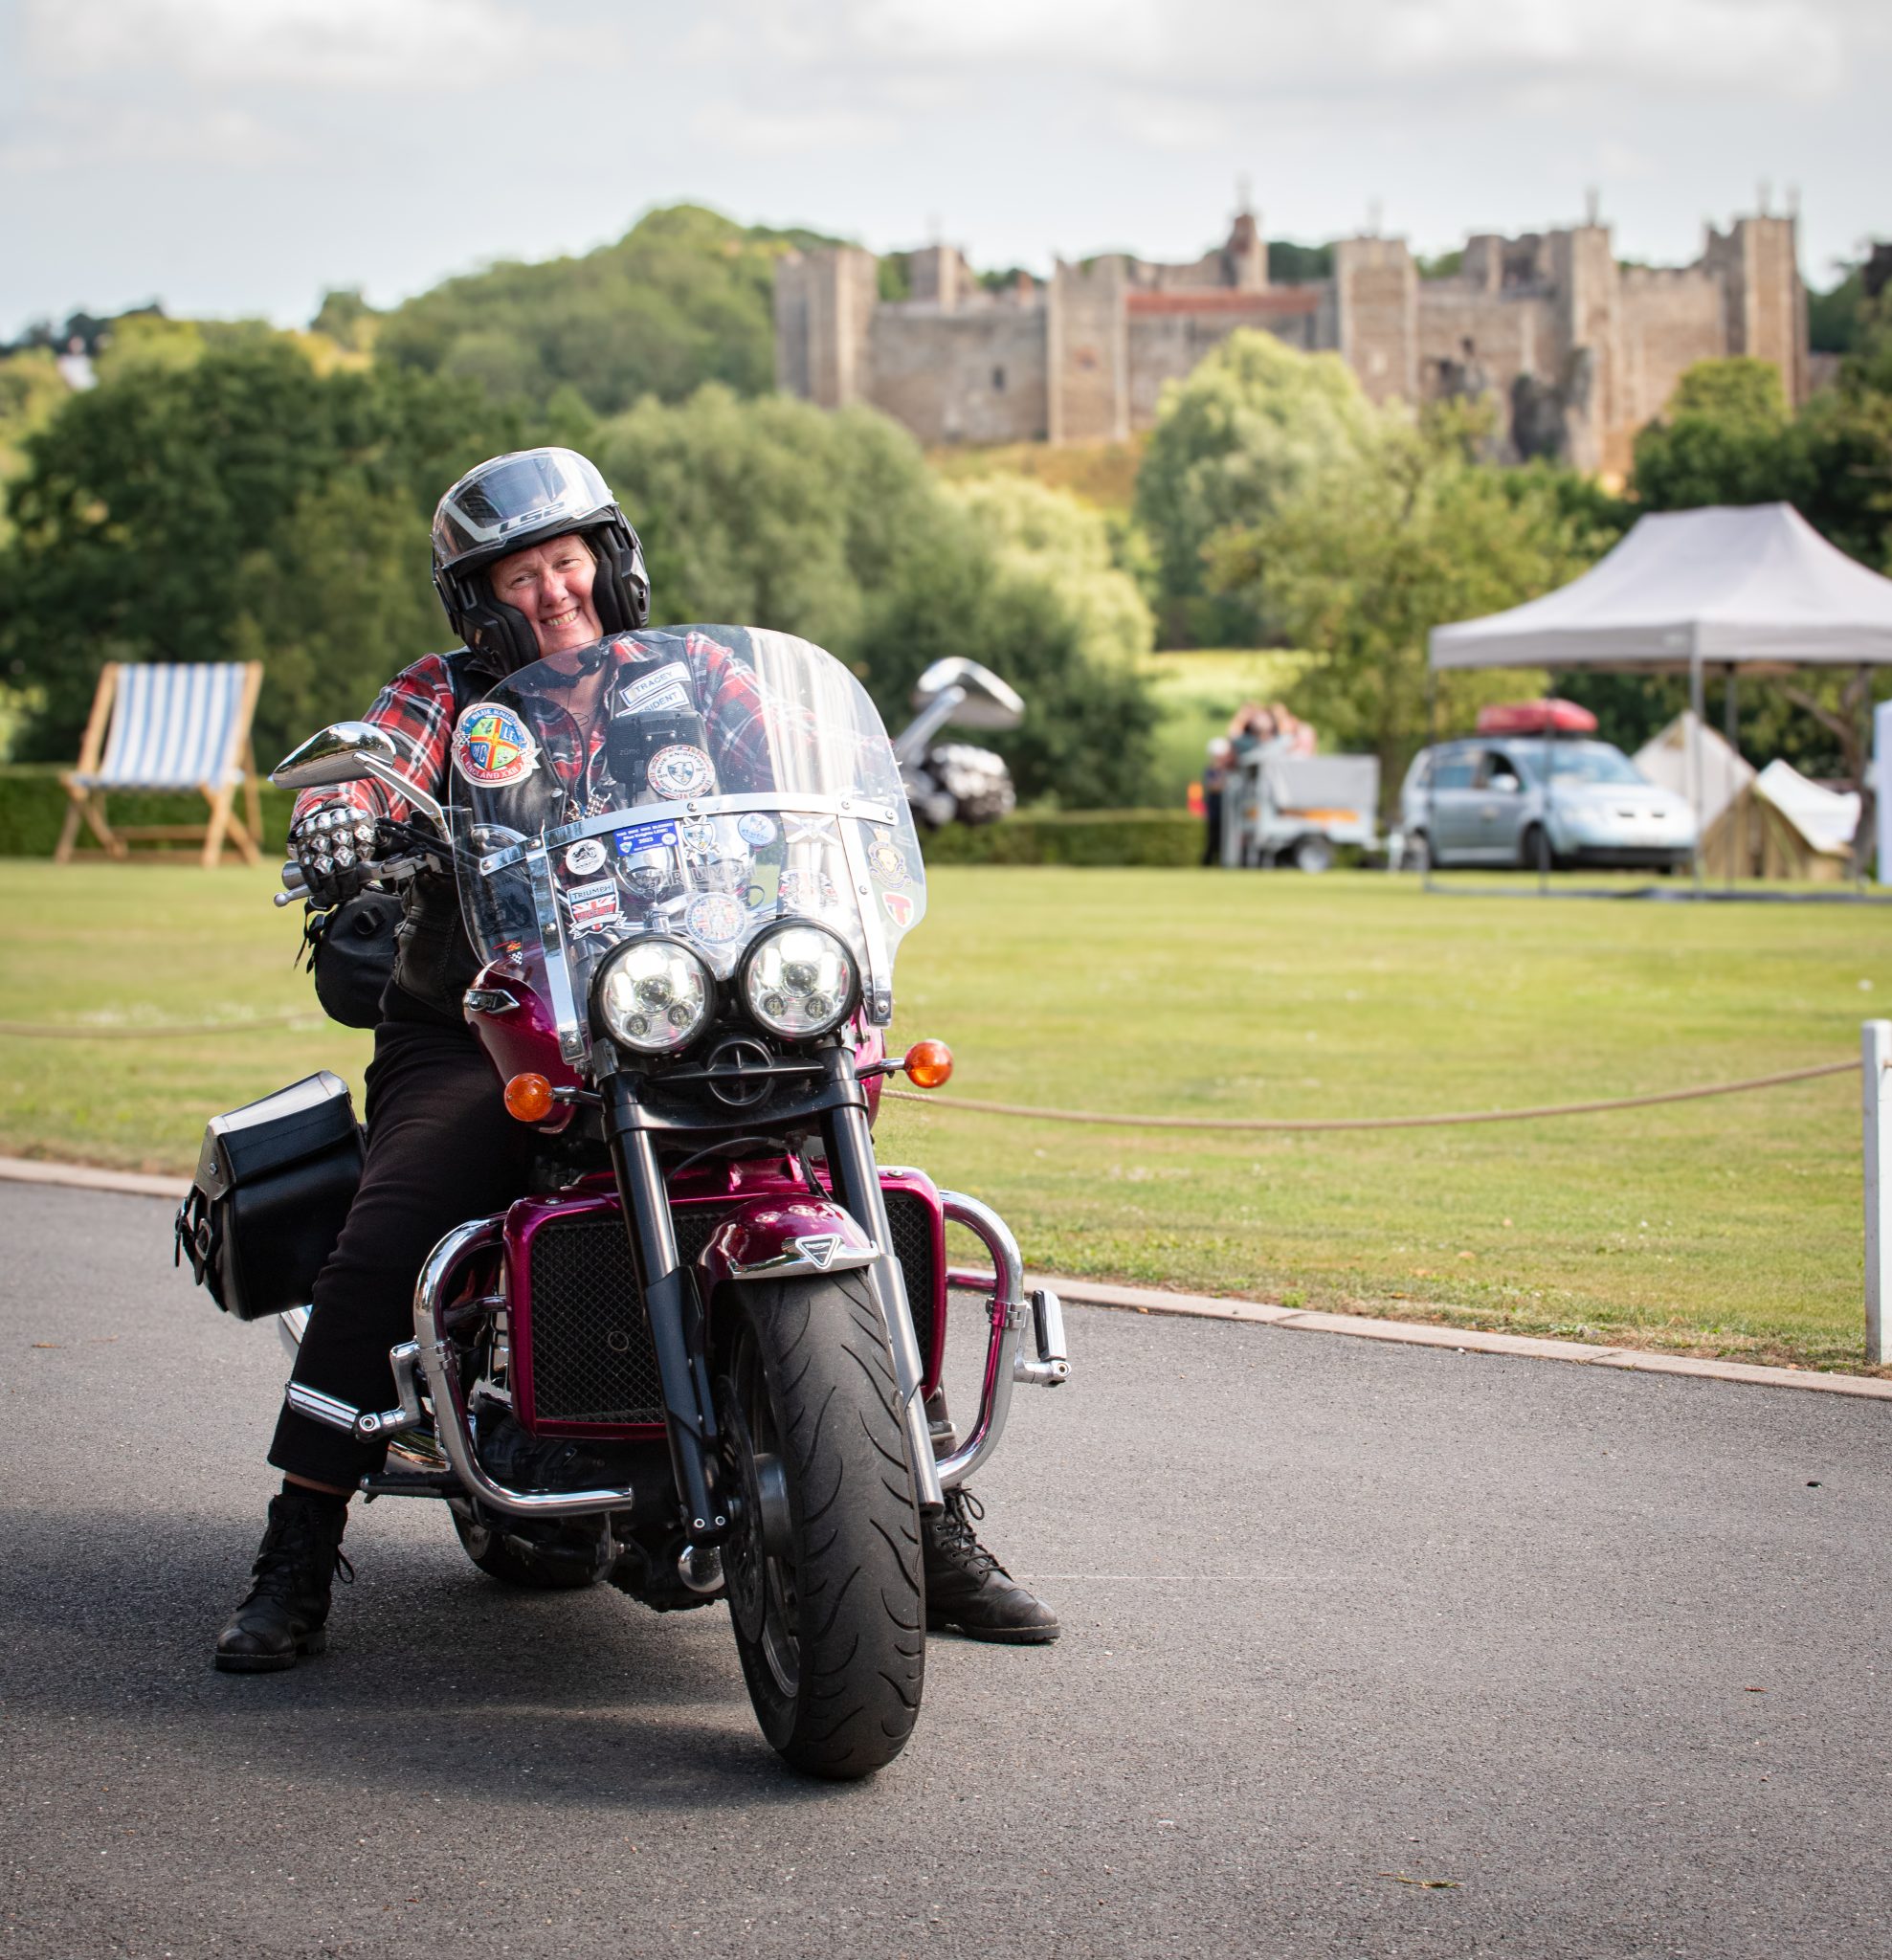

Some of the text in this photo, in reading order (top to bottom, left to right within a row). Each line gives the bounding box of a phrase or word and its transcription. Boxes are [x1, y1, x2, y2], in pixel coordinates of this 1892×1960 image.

[499, 501, 565, 534] LS2
[634, 671, 673, 693] TRACEY
[643, 691, 678, 711] SIDENT
[472, 708, 493, 720] BLUE
[502, 726, 516, 742] LE
[473, 745, 487, 763] MC
[464, 761, 500, 779] ENGLAND
[572, 884, 612, 900] TRIUMPH
